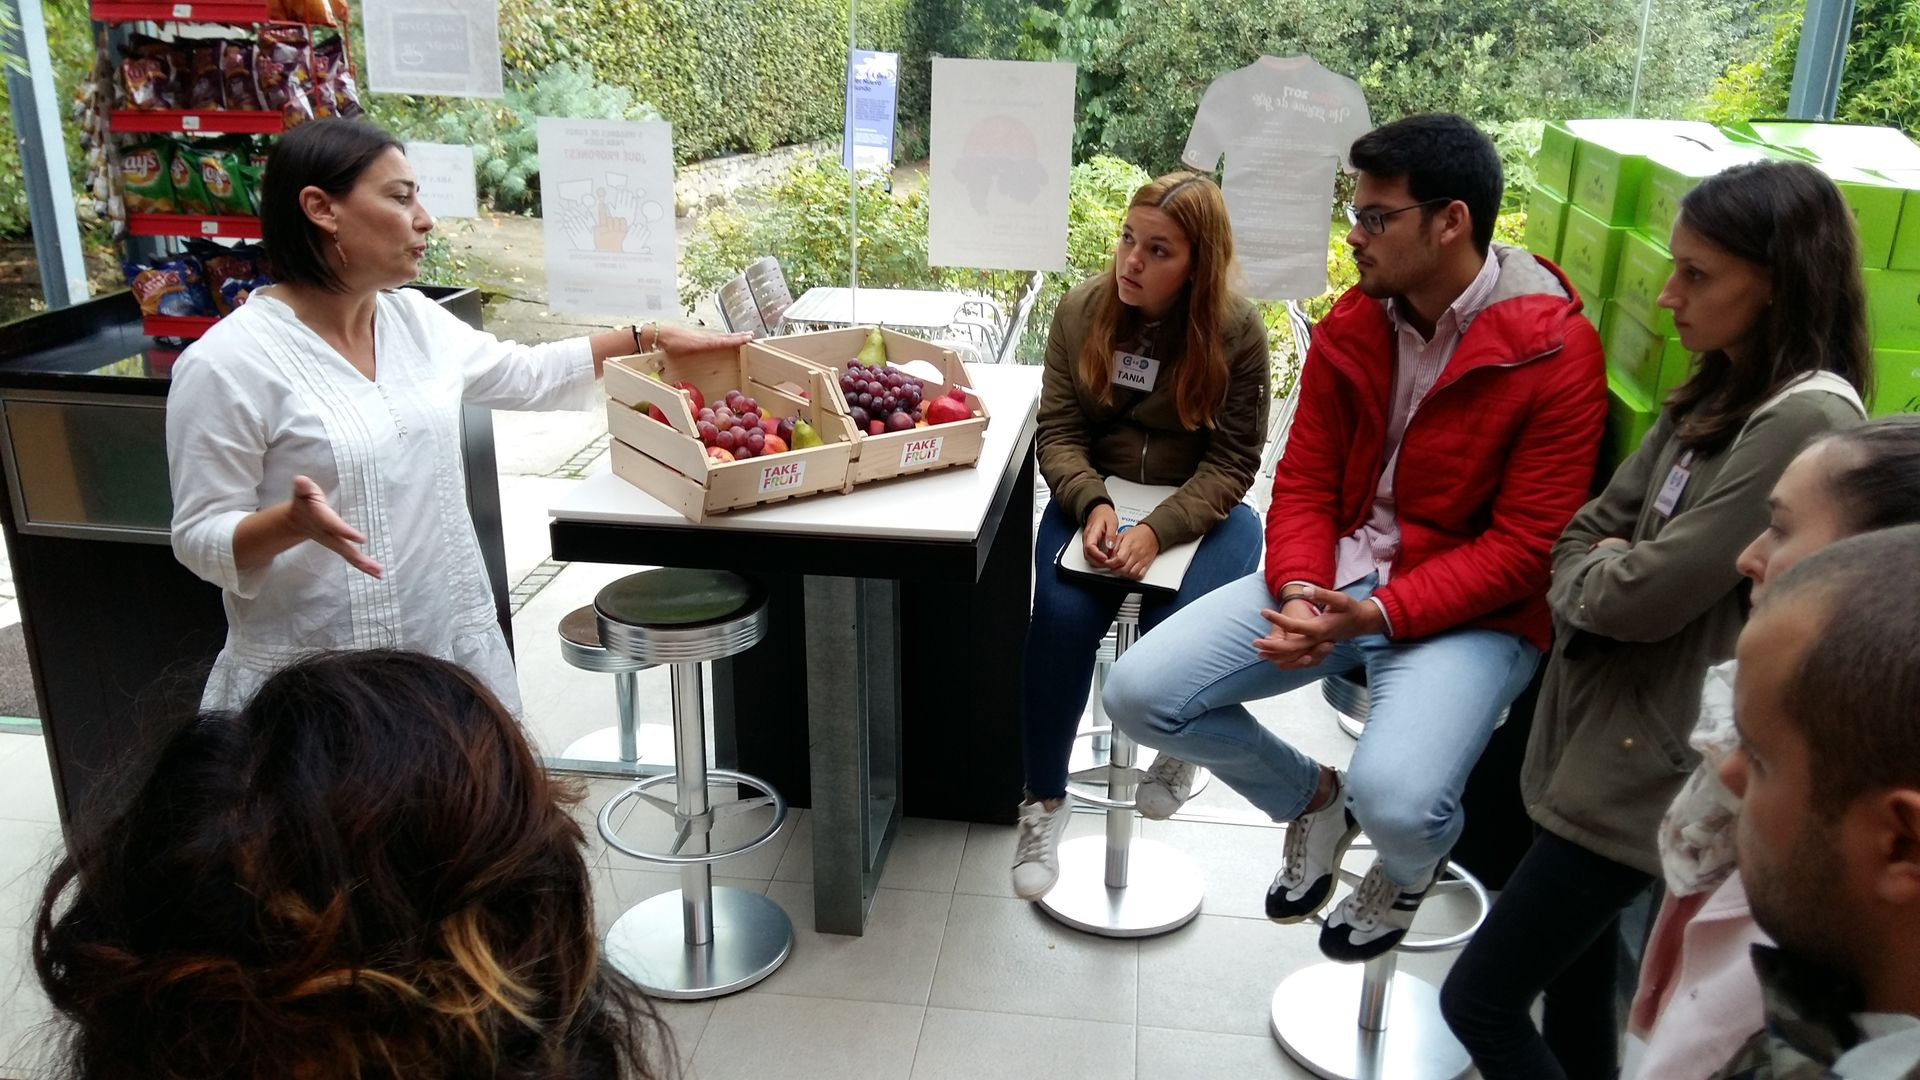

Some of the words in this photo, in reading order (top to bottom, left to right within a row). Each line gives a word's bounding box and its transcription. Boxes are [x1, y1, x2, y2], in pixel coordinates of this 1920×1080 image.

[1118, 371, 1145, 385] TANIA
[906, 438, 937, 453] TAKE
[904, 447, 939, 464] FRUIT
[763, 462, 798, 479] TAKE
[763, 471, 802, 489] FRUIT
